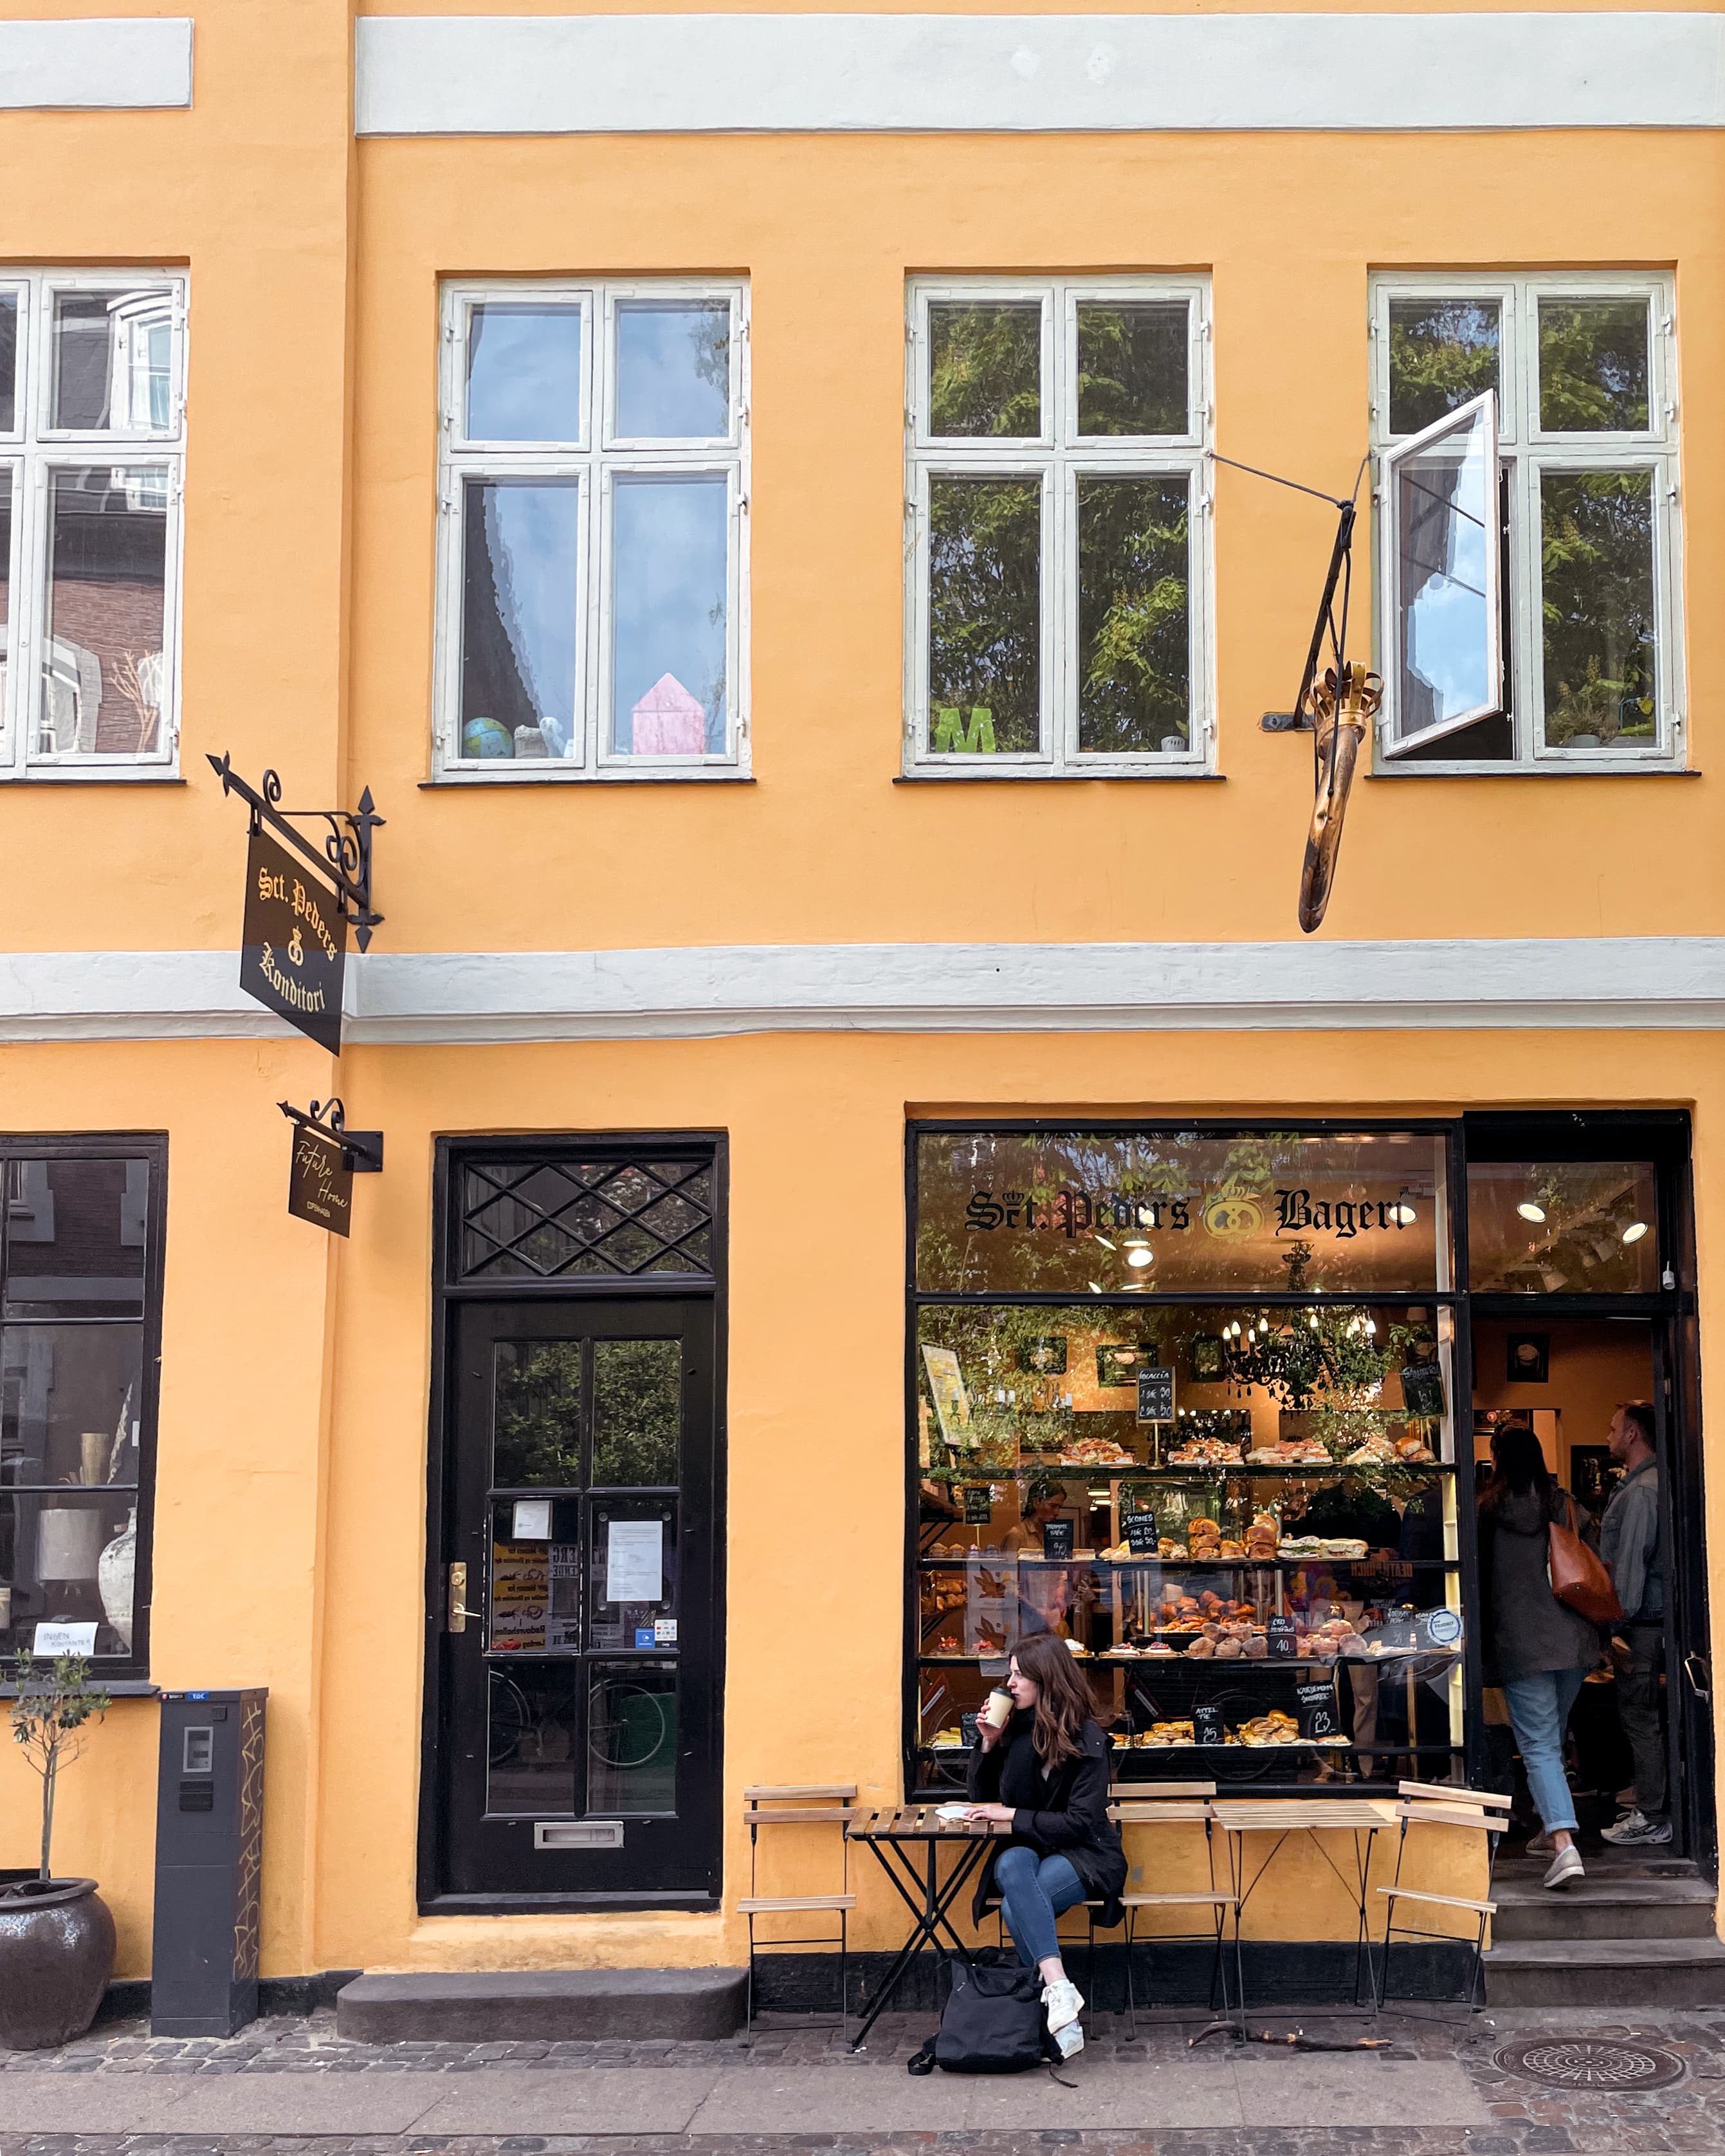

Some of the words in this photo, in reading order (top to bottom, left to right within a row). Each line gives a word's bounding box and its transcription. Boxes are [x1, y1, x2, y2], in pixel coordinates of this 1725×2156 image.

[935, 708, 996, 753] M
[258, 866, 289, 903] Sct.
[291, 879, 338, 962] Peders
[259, 942, 325, 1013] Konditori
[296, 1140, 333, 1178] Future
[318, 1178, 348, 1208] Home
[964, 1190, 1048, 1231] Sct.
[1056, 1190, 1191, 1239] Peders
[1273, 1188, 1407, 1239] Bageri
[1126, 1513, 1153, 1524] SCONES
[44, 1632, 69, 1641] INGEN
